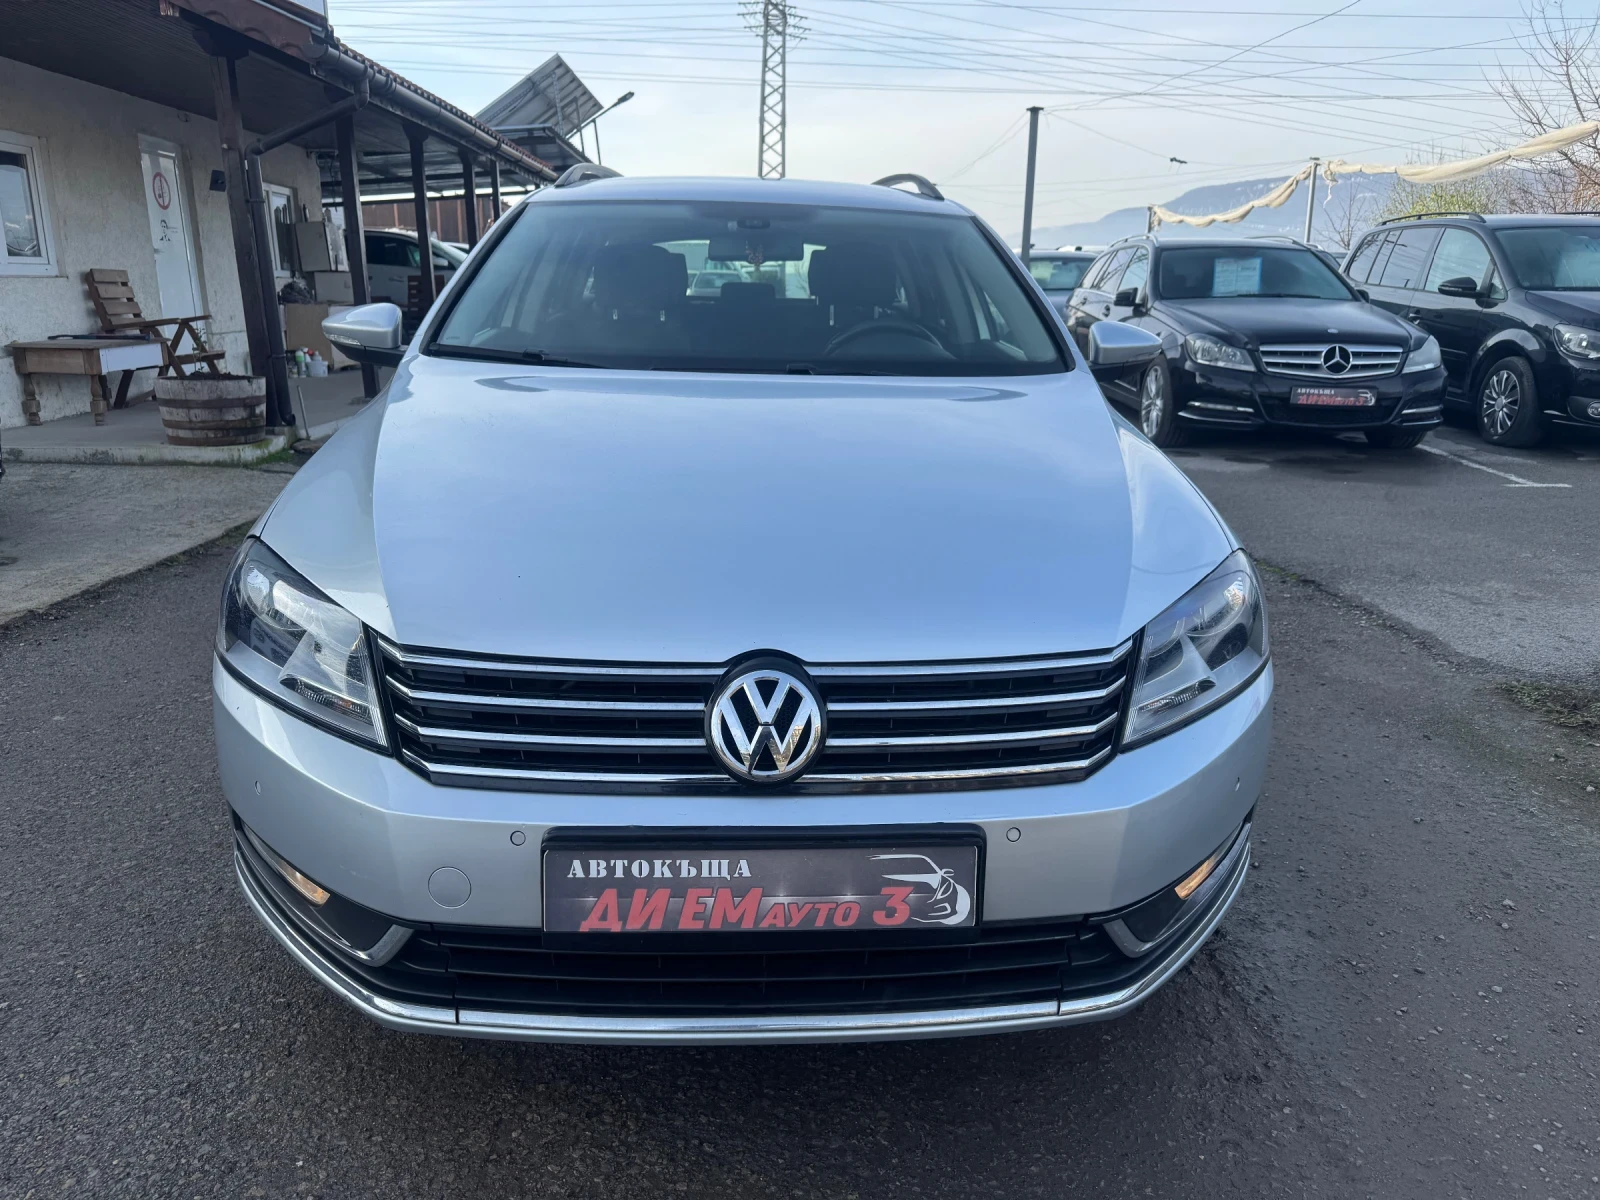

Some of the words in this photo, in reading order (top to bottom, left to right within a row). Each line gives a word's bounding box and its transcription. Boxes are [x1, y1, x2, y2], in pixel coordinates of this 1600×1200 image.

[566, 858, 753, 881] АВТОКЪЩА
[579, 887, 672, 933] ДИ
[872, 886, 914, 926] 3
